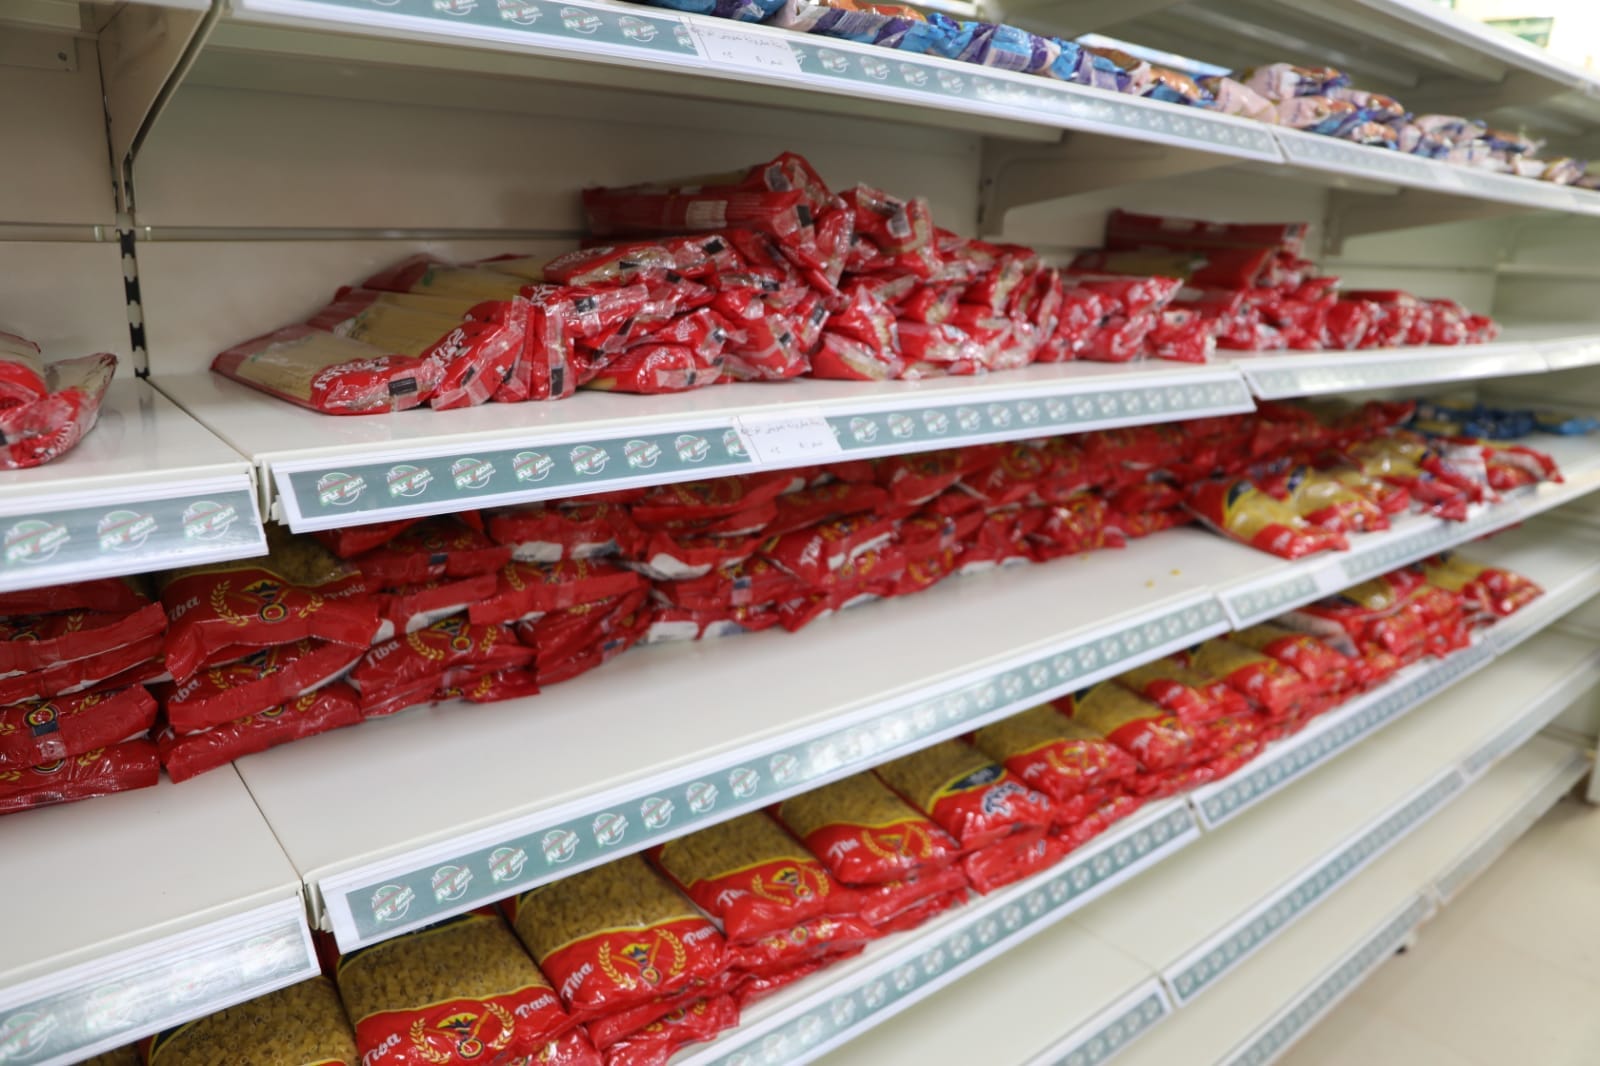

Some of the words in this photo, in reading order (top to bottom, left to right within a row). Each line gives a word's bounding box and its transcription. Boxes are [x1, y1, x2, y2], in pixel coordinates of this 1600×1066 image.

[366, 640, 401, 668] Tiba
[560, 962, 594, 1001] Tiba
[362, 1032, 401, 1066] Tiba
